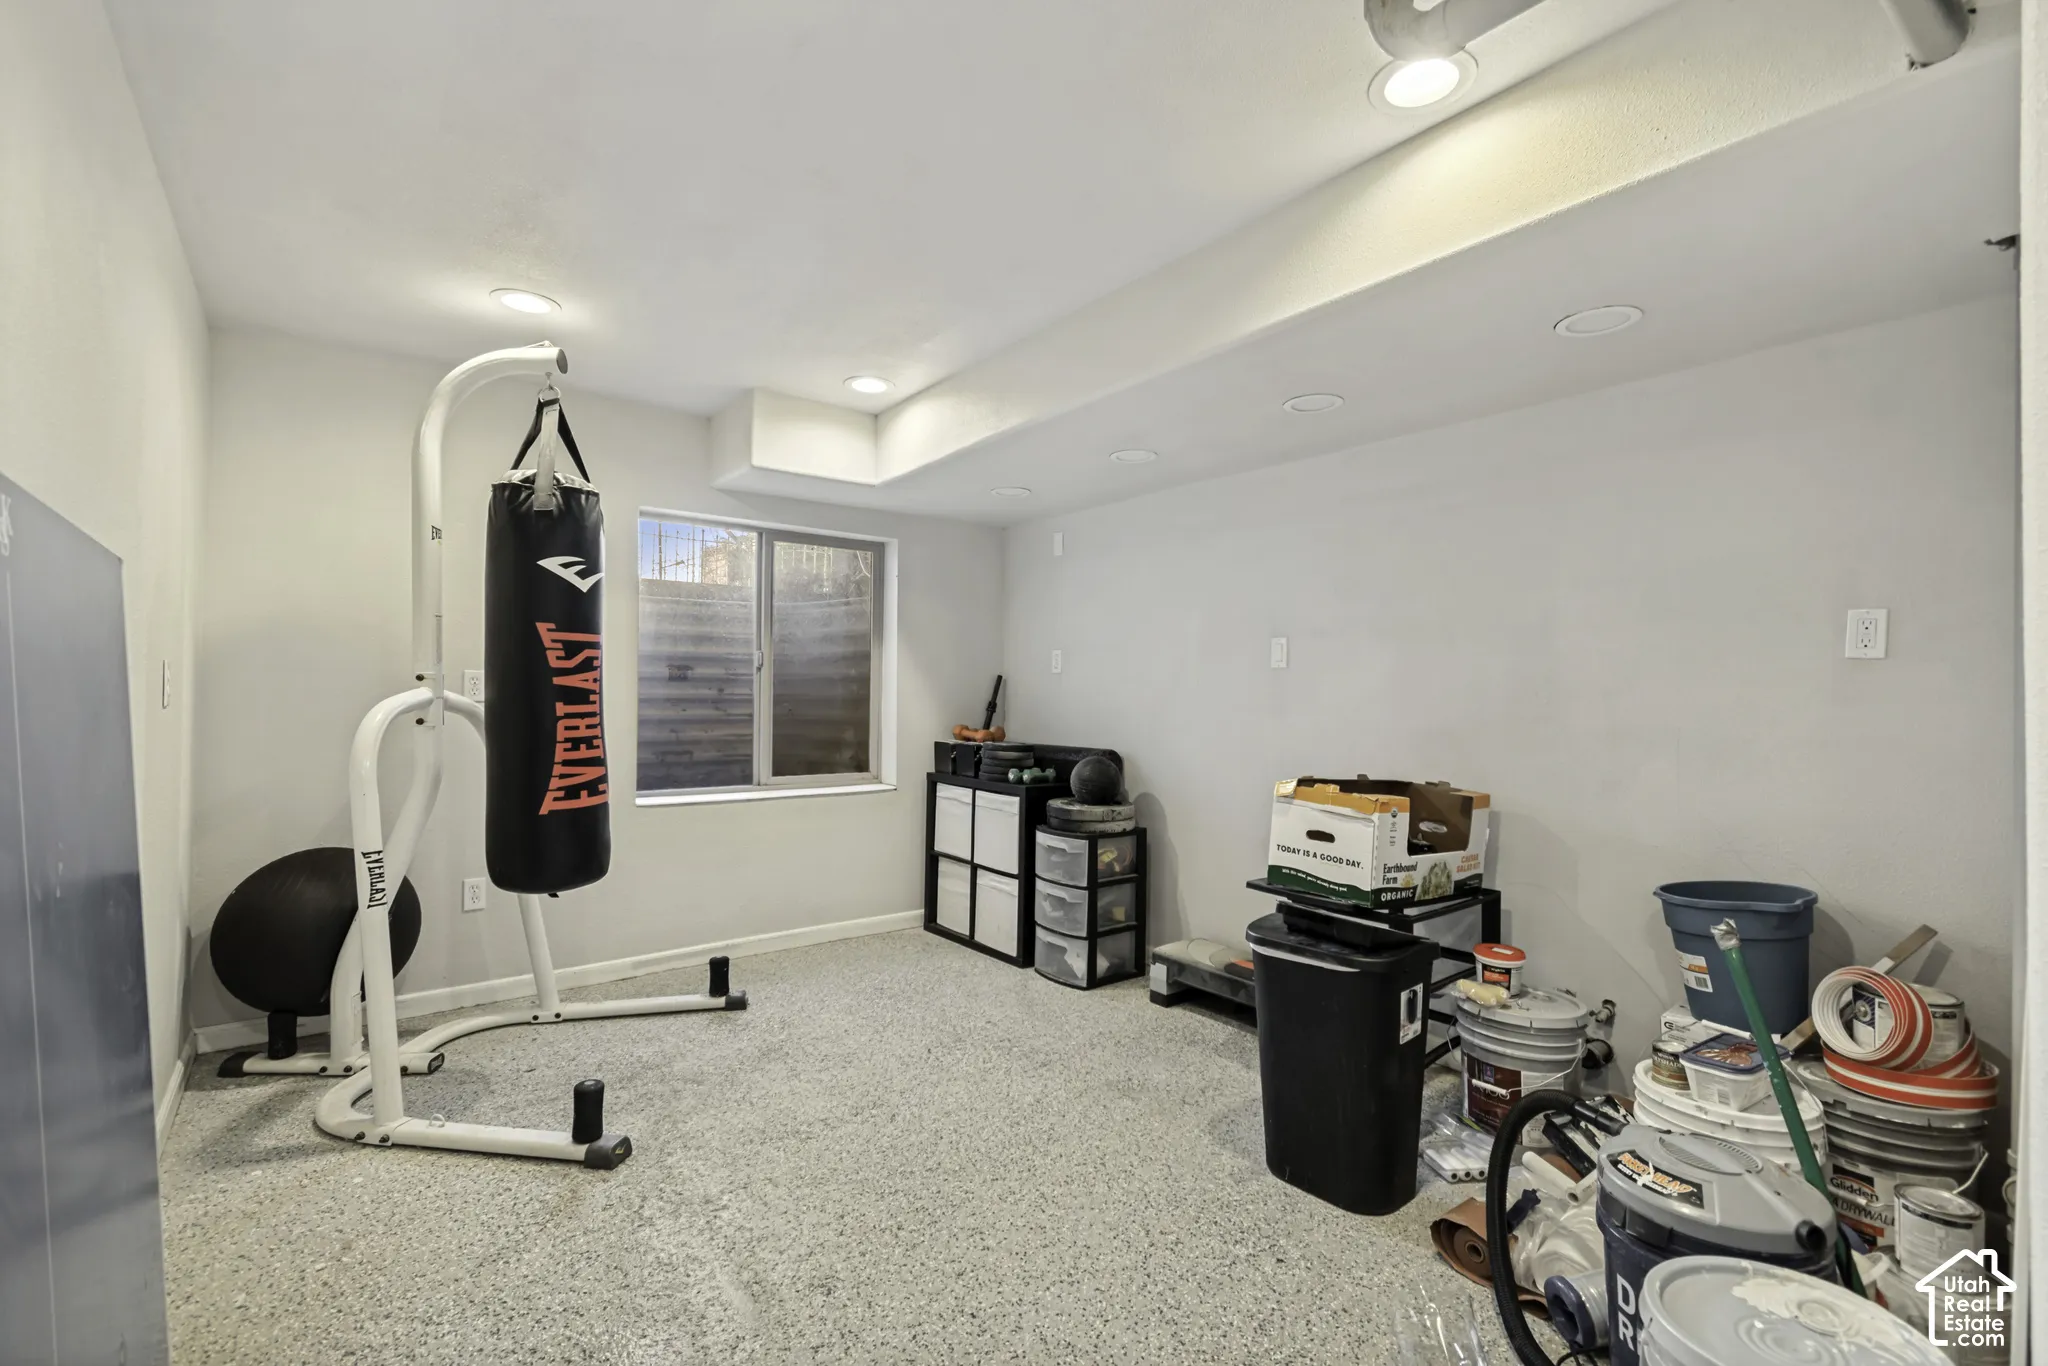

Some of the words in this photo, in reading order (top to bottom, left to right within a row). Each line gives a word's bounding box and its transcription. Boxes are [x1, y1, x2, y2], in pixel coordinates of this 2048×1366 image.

[535, 622, 609, 815] EVERLAST
[1277, 844, 1301, 855] TODAY
[1303, 849, 1311, 858] IS
[1320, 853, 1344, 865] GOOD
[1345, 859, 1364, 870] DAY.
[1383, 861, 1418, 874] Earthbound
[361, 850, 388, 910] EVERLAST
[1382, 874, 1398, 885] Farm
[1381, 889, 1414, 901] ORGANIC
[1830, 1177, 1879, 1202] Glidden
